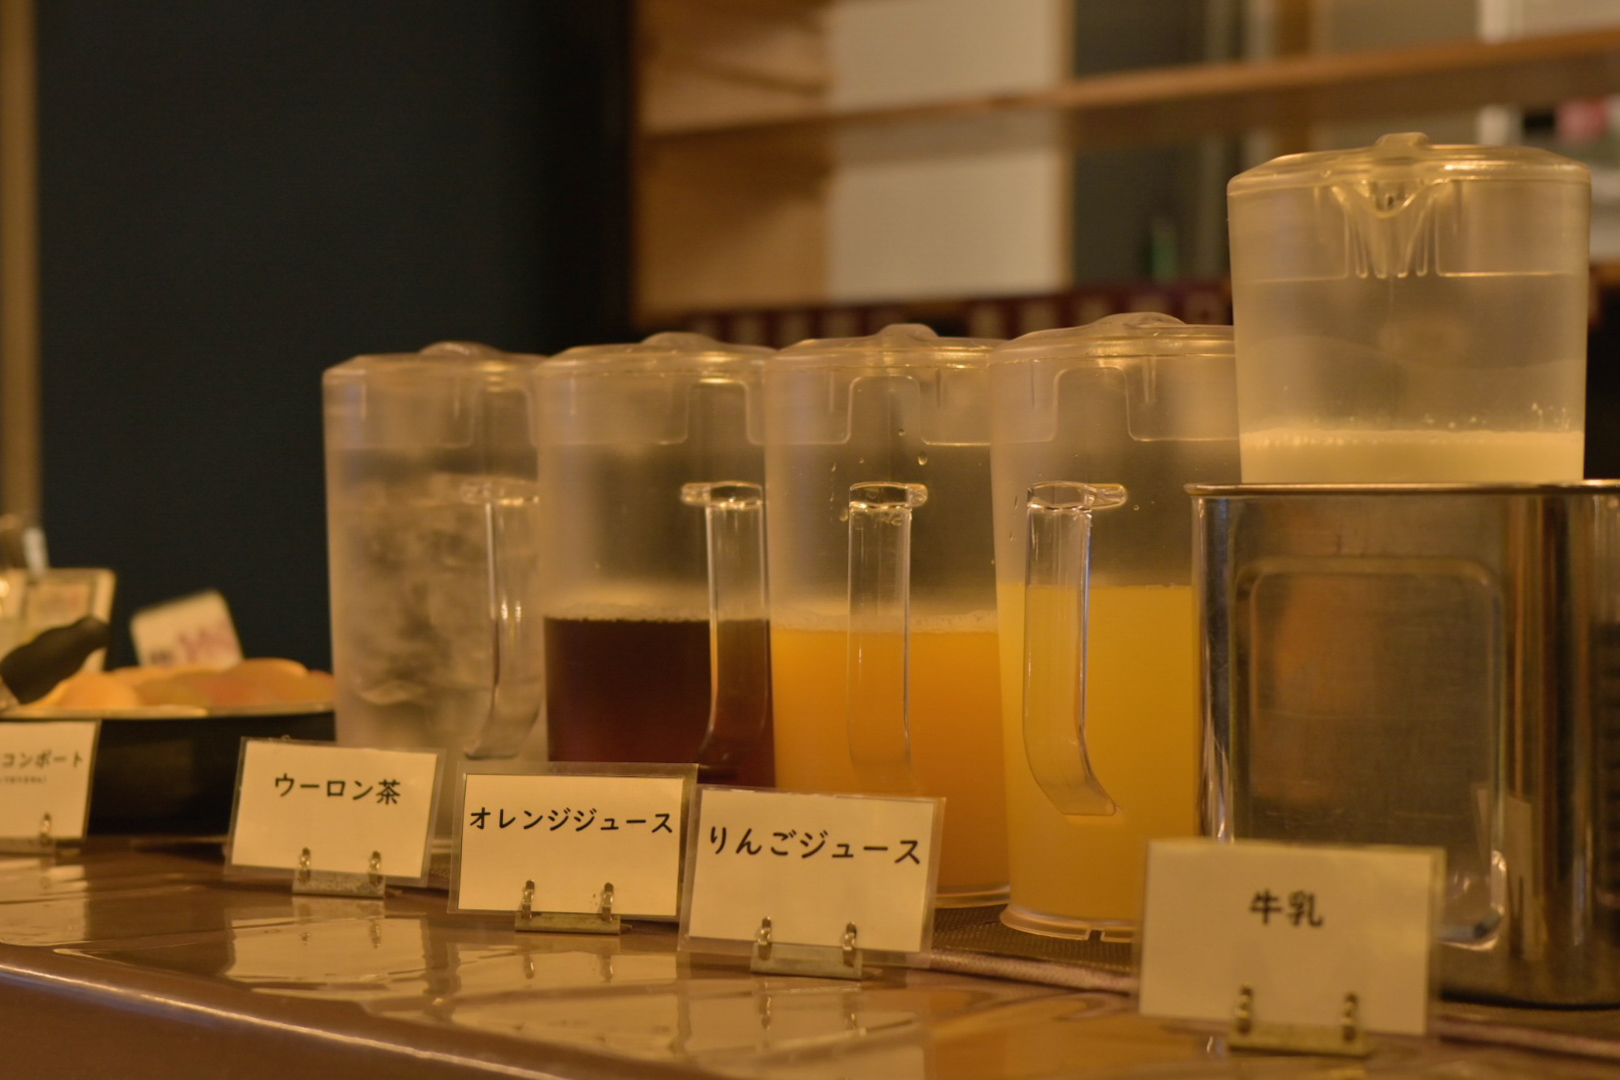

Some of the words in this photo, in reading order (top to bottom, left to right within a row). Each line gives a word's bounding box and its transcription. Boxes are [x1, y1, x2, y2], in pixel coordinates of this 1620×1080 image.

[275, 773, 401, 805] ウーロン茶
[469, 807, 673, 834] オレンジジュース
[710, 826, 920, 865] りんごジュース
[1248, 888, 1325, 928] 牛乳
